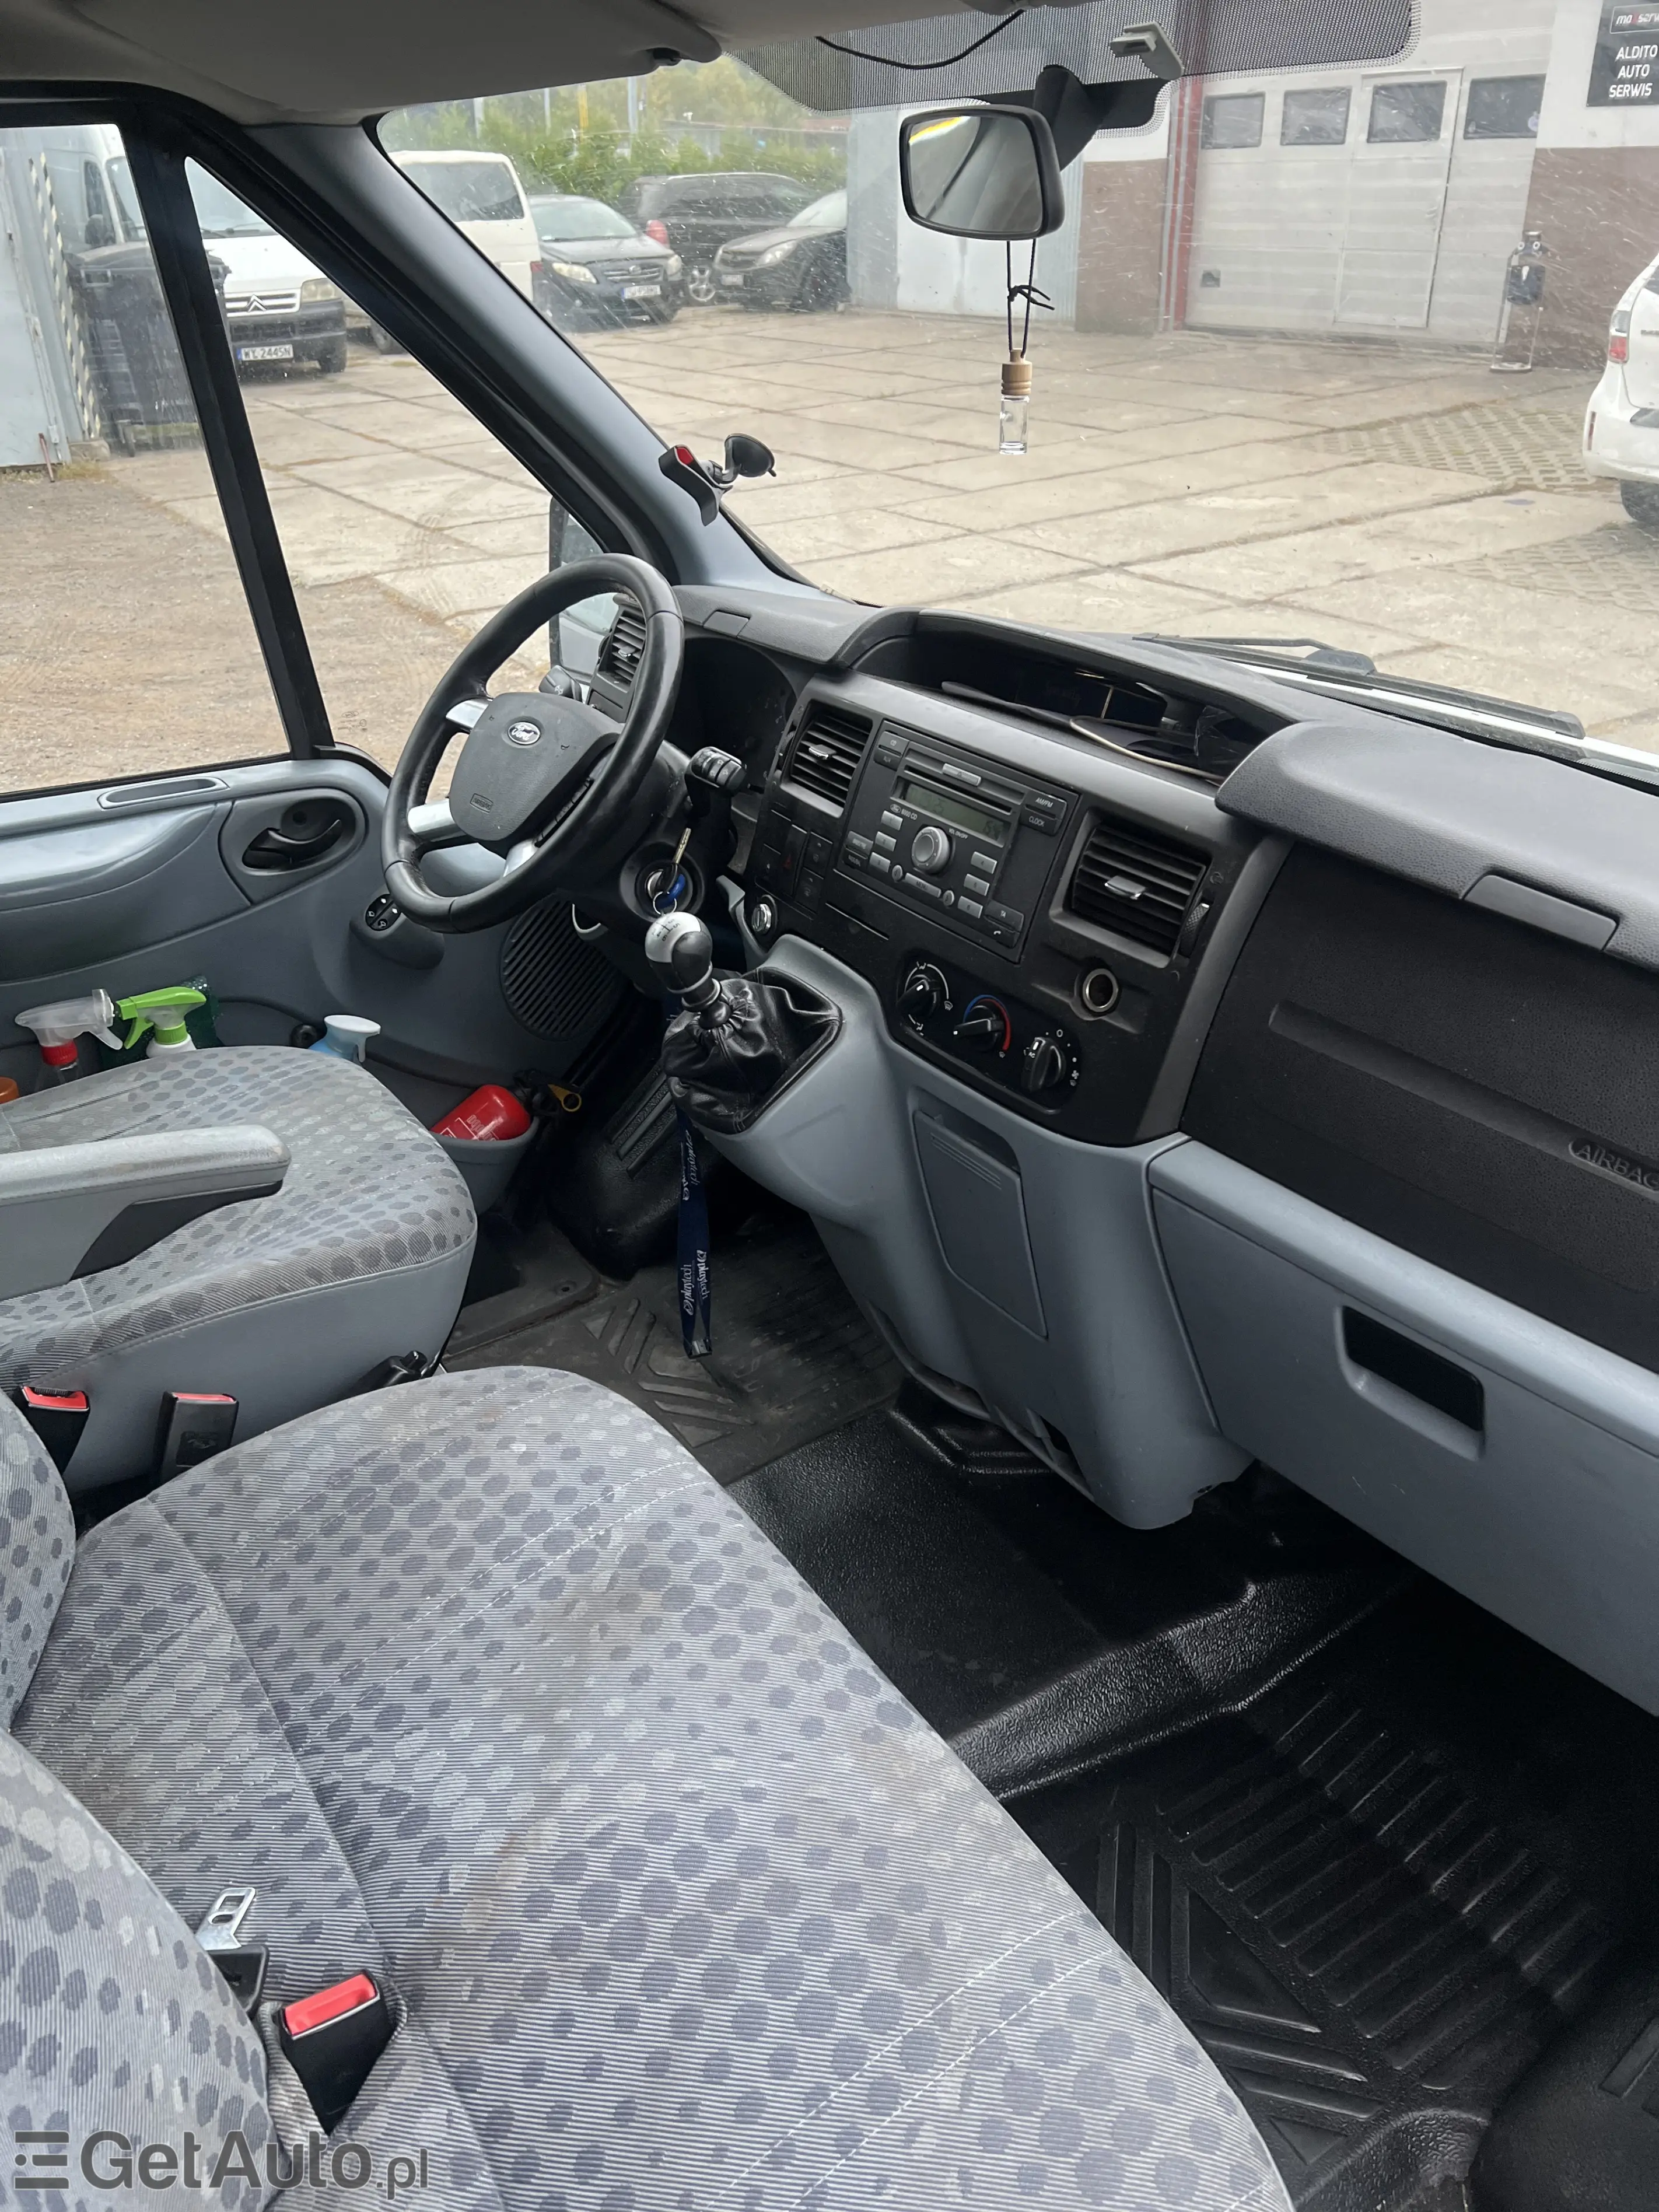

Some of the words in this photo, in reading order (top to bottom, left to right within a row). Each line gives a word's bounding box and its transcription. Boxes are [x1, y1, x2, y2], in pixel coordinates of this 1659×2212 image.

[1616, 44, 1658, 60] ALDITO
[1618, 64, 1650, 79] AUTO
[1609, 83, 1653, 98] SERWIS
[1035, 797, 1054, 808] AM/FM
[910, 812, 918, 820] CD
[1028, 816, 1045, 828] CLOCK
[1574, 1144, 1659, 1191] AIRBAG
[680, 1264, 695, 1303] playtech
[696, 1262, 711, 1300] playtech
